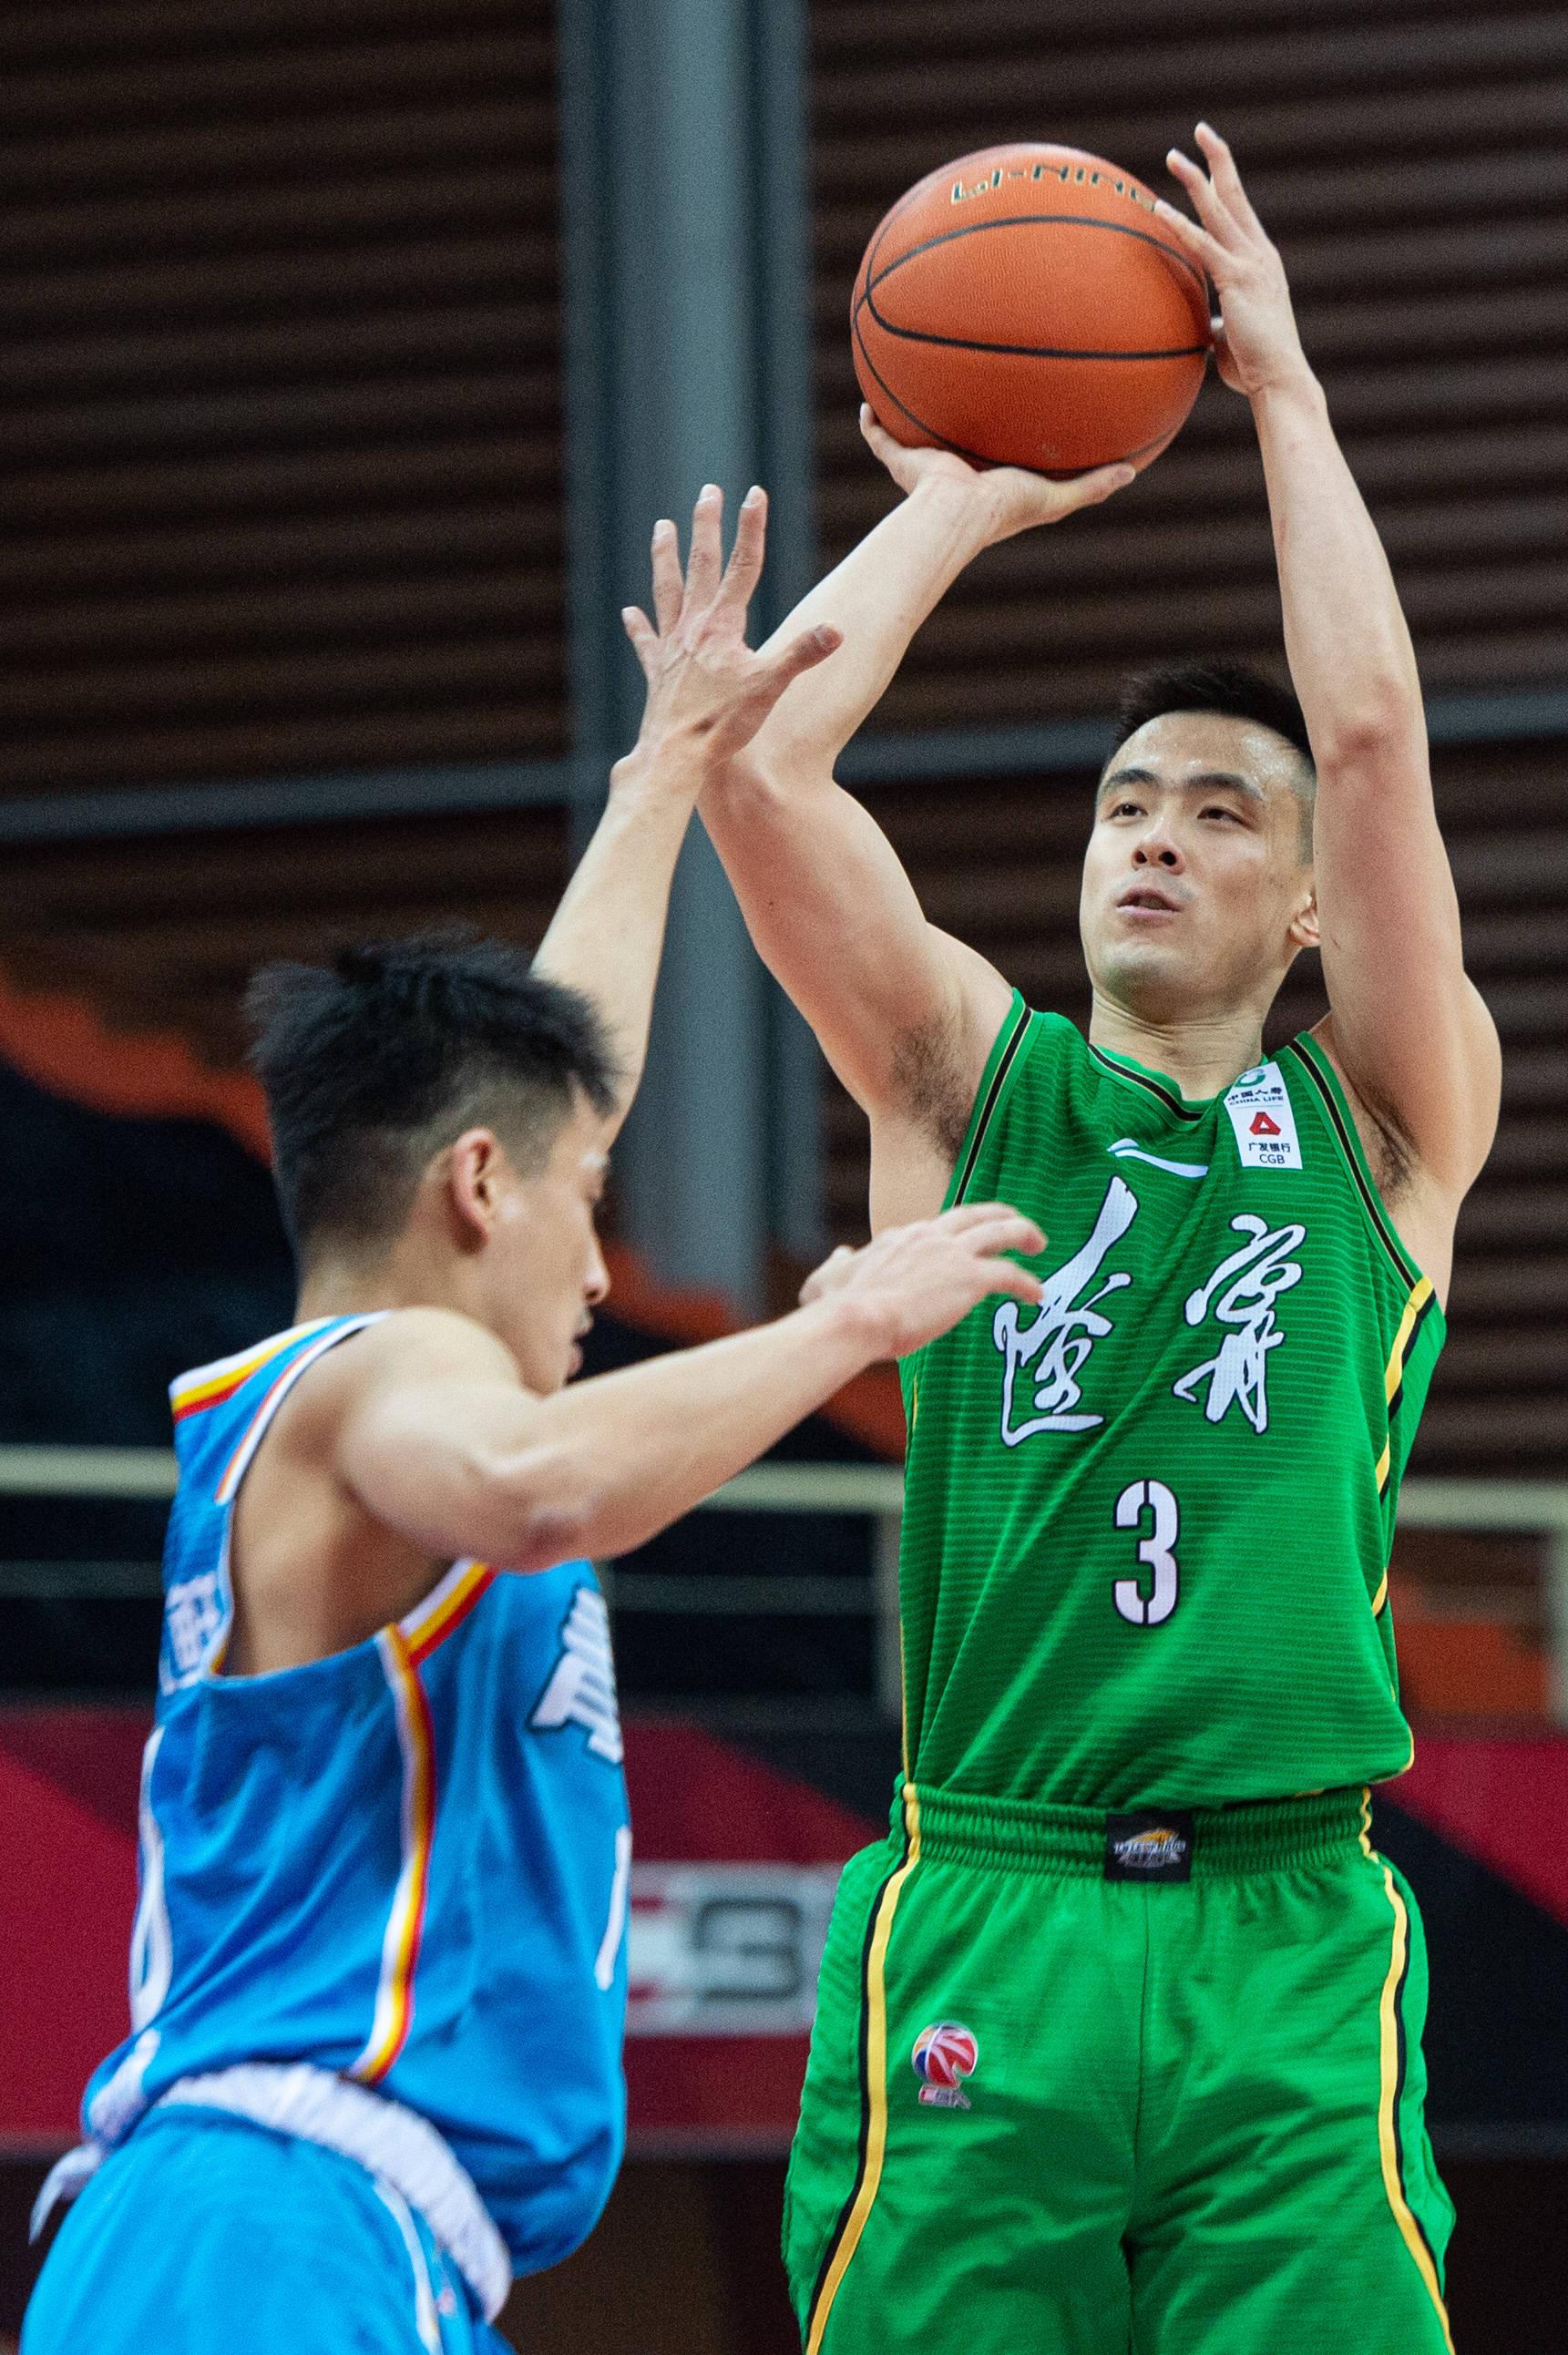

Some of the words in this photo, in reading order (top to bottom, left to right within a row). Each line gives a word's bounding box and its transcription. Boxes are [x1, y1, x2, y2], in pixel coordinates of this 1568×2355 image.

[1229, 1097, 1261, 1106] CHINA
[1248, 1142, 1291, 1153] 广发银行
[1259, 1153, 1286, 1164] CGB
[1112, 1478, 1181, 1625] 3
